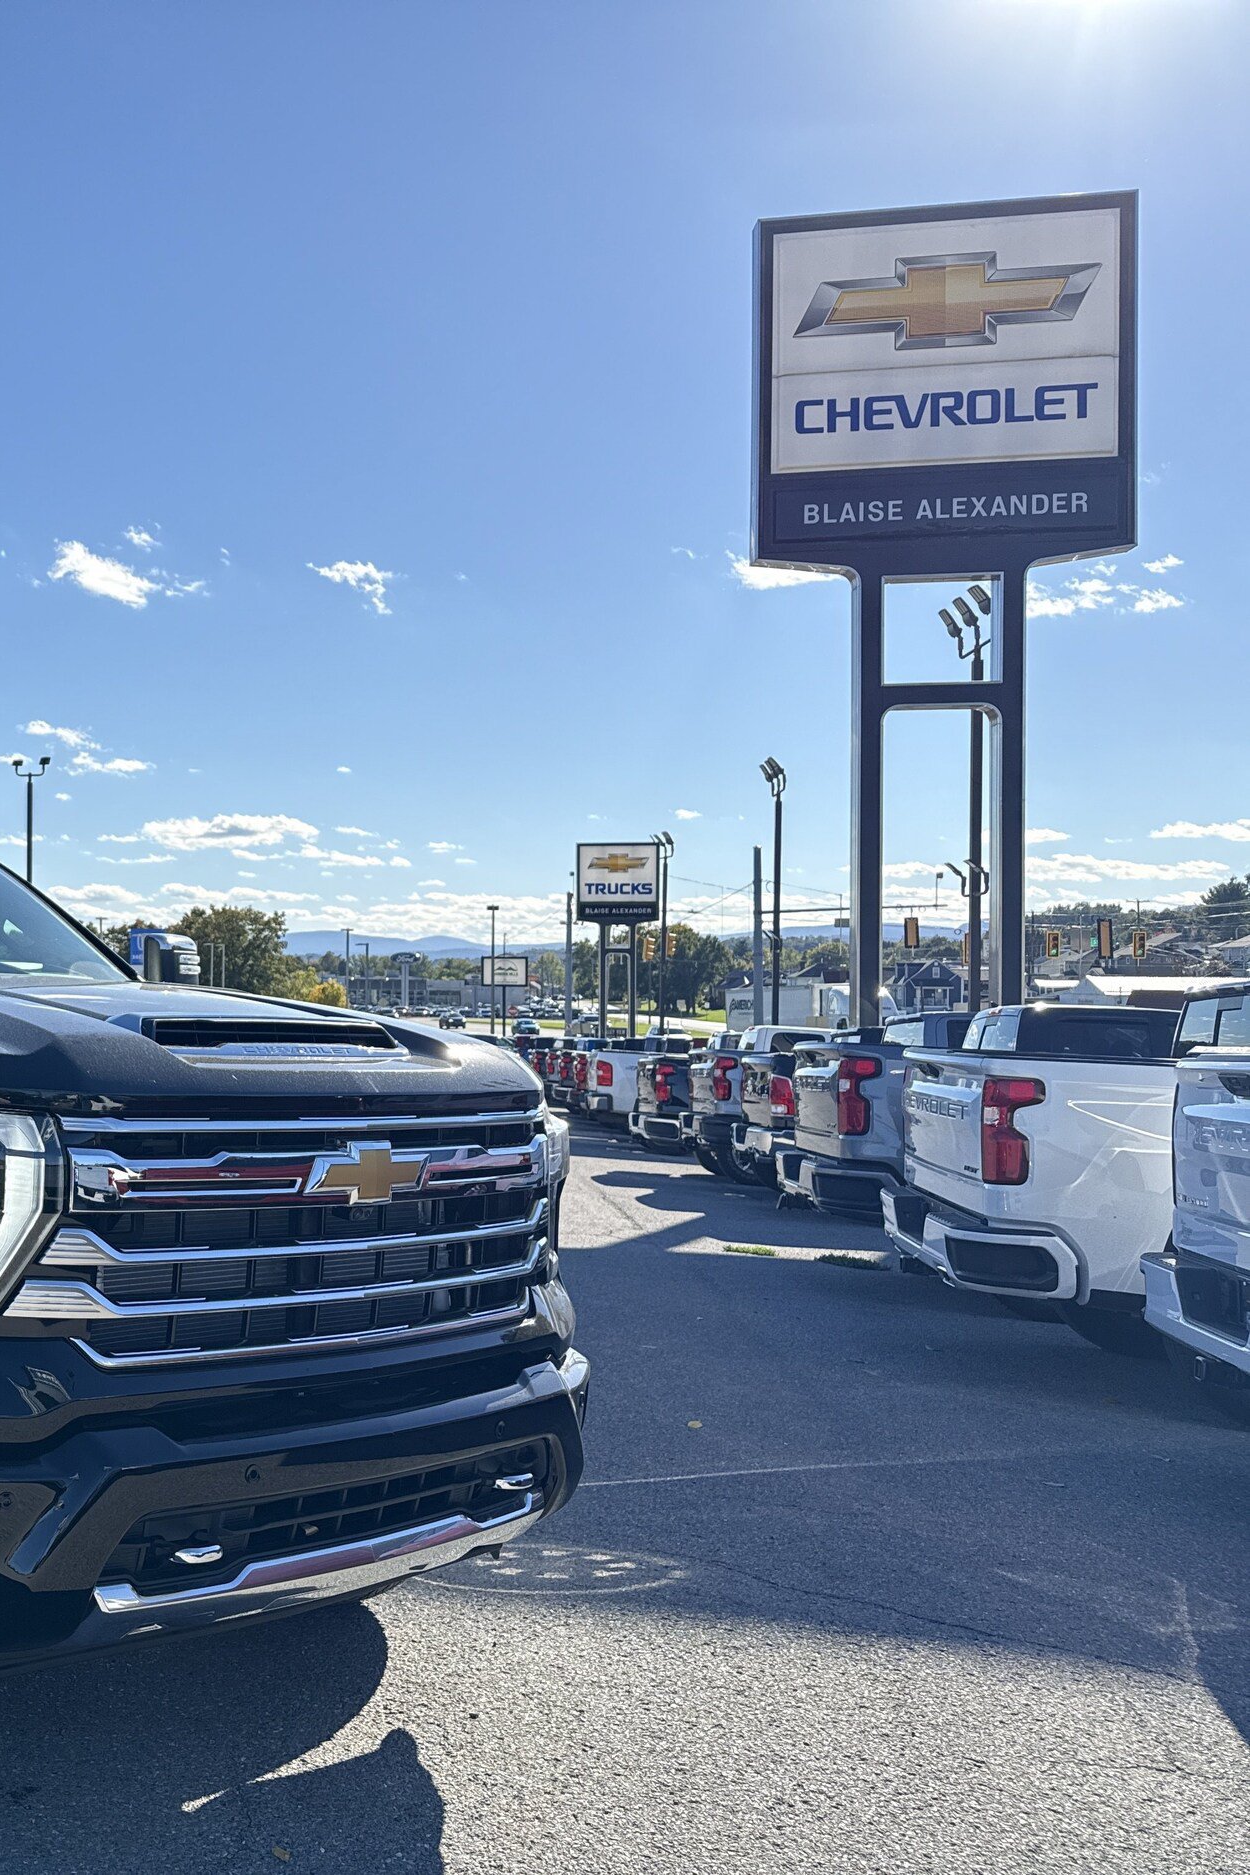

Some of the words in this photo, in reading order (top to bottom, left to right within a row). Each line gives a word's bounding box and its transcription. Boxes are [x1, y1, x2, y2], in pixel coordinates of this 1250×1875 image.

[795, 382, 1099, 435] CHEVROLET
[803, 499, 903, 525] BLAISE
[916, 491, 1089, 520] ALEXANDER
[584, 882, 653, 895] TRUCKS
[242, 1045, 351, 1055] CHEVROLET
